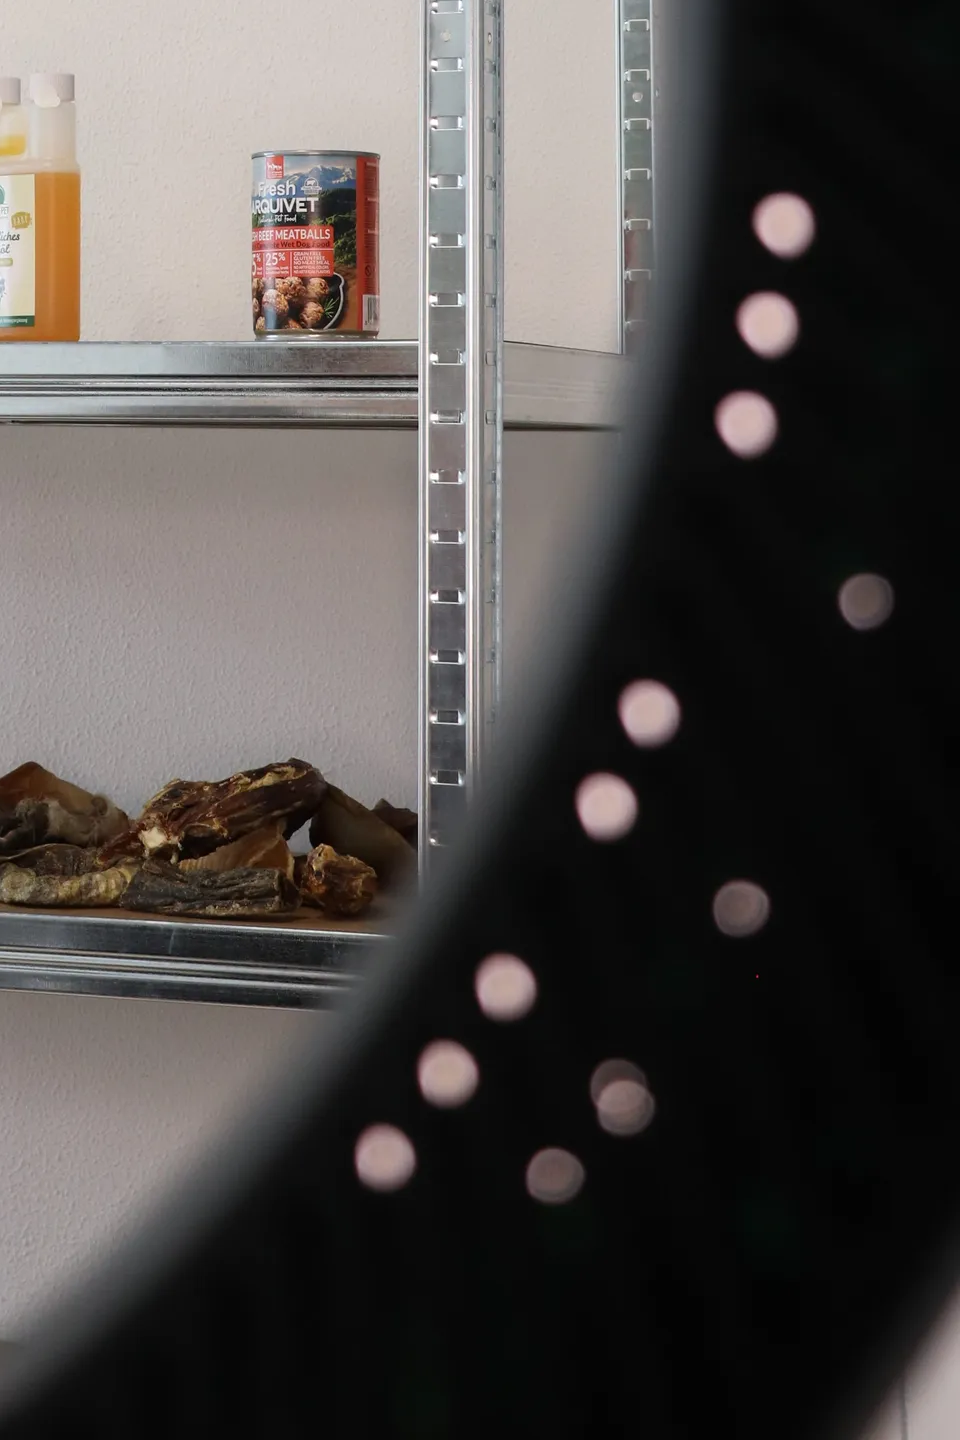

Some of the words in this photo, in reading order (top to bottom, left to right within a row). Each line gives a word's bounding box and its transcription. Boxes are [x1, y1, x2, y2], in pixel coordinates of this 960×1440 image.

[258, 179, 296, 197] Fresh
[258, 230, 274, 241] BEEF
[275, 229, 331, 240] MEATBALLS
[280, 240, 296, 248] Wet
[296, 239, 311, 249] Dog
[312, 239, 330, 248] Food
[265, 252, 286, 266] 25%
